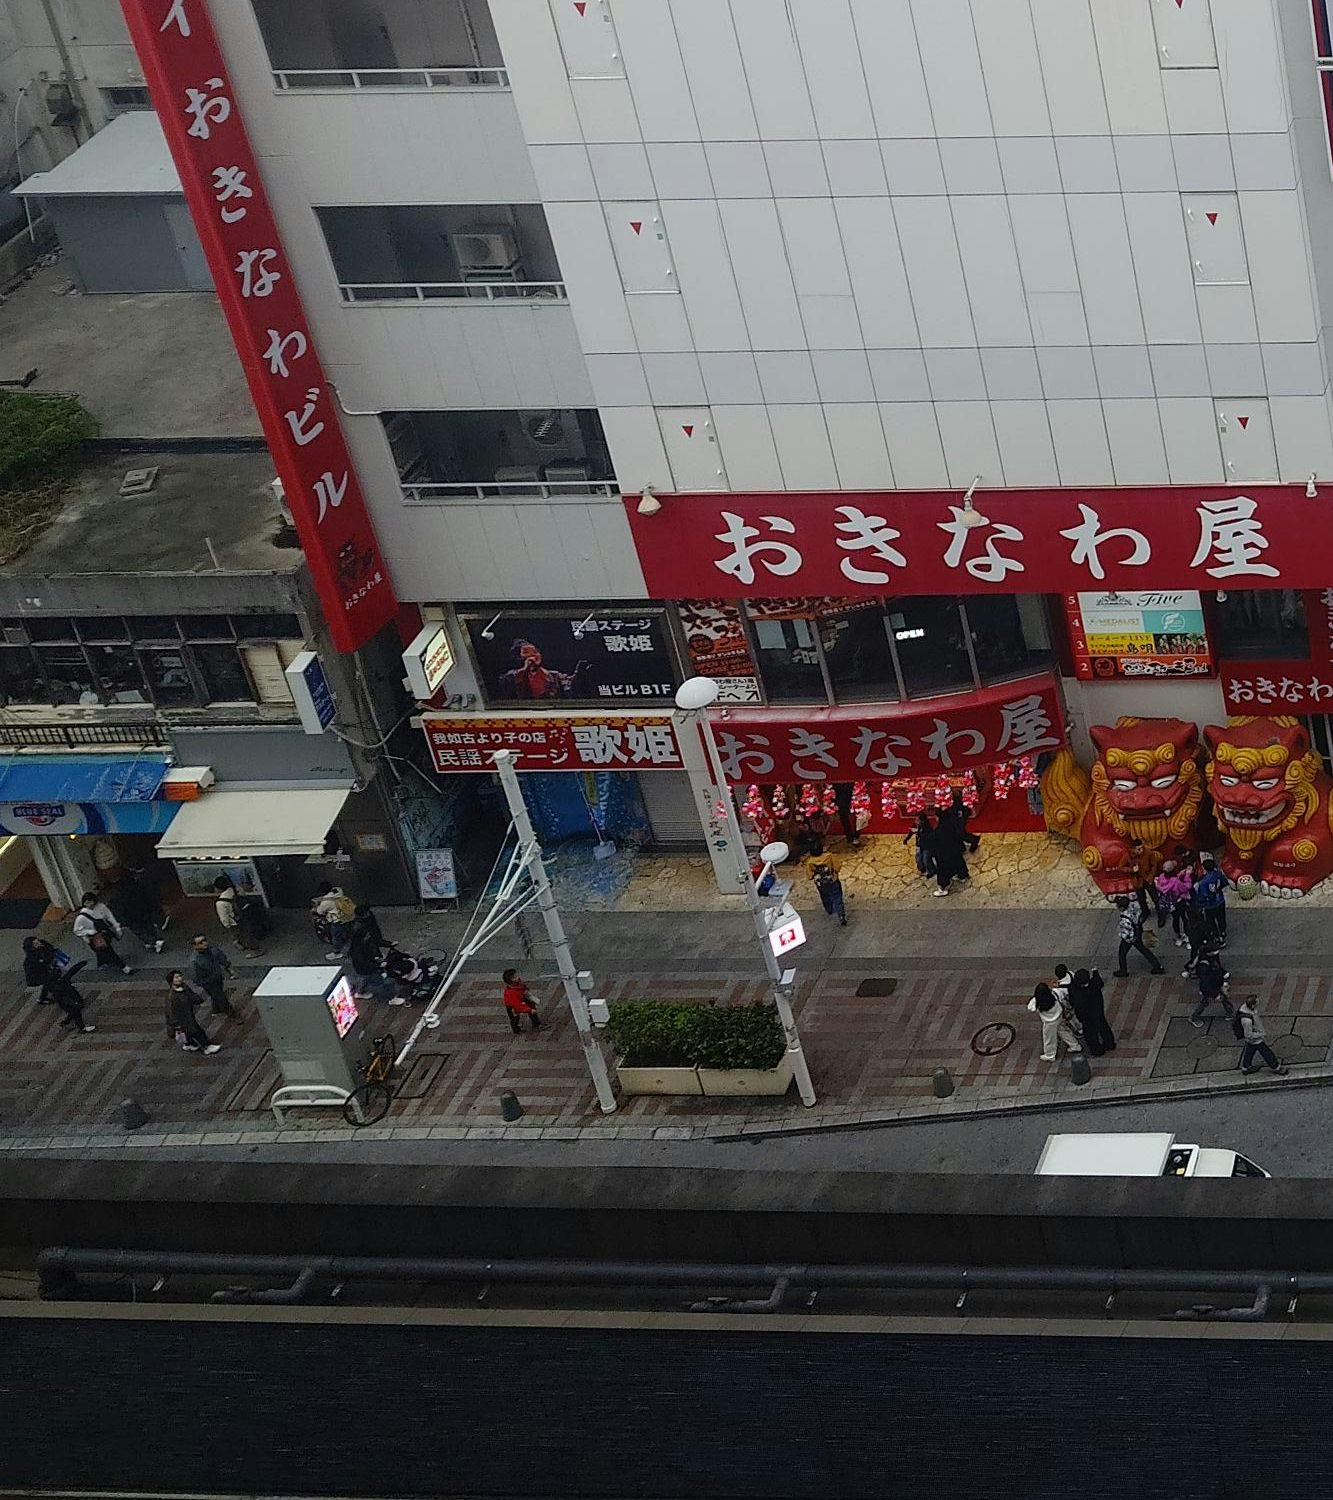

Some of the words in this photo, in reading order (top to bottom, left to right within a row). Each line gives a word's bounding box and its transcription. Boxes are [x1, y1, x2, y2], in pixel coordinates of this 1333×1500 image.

[714, 496, 1281, 585] おきなわ屋
[604, 634, 655, 653] 歌姫
[895, 628, 925, 641] OPEN
[571, 724, 681, 765] 歌姫
[718, 694, 1060, 780] おきなわ屋
